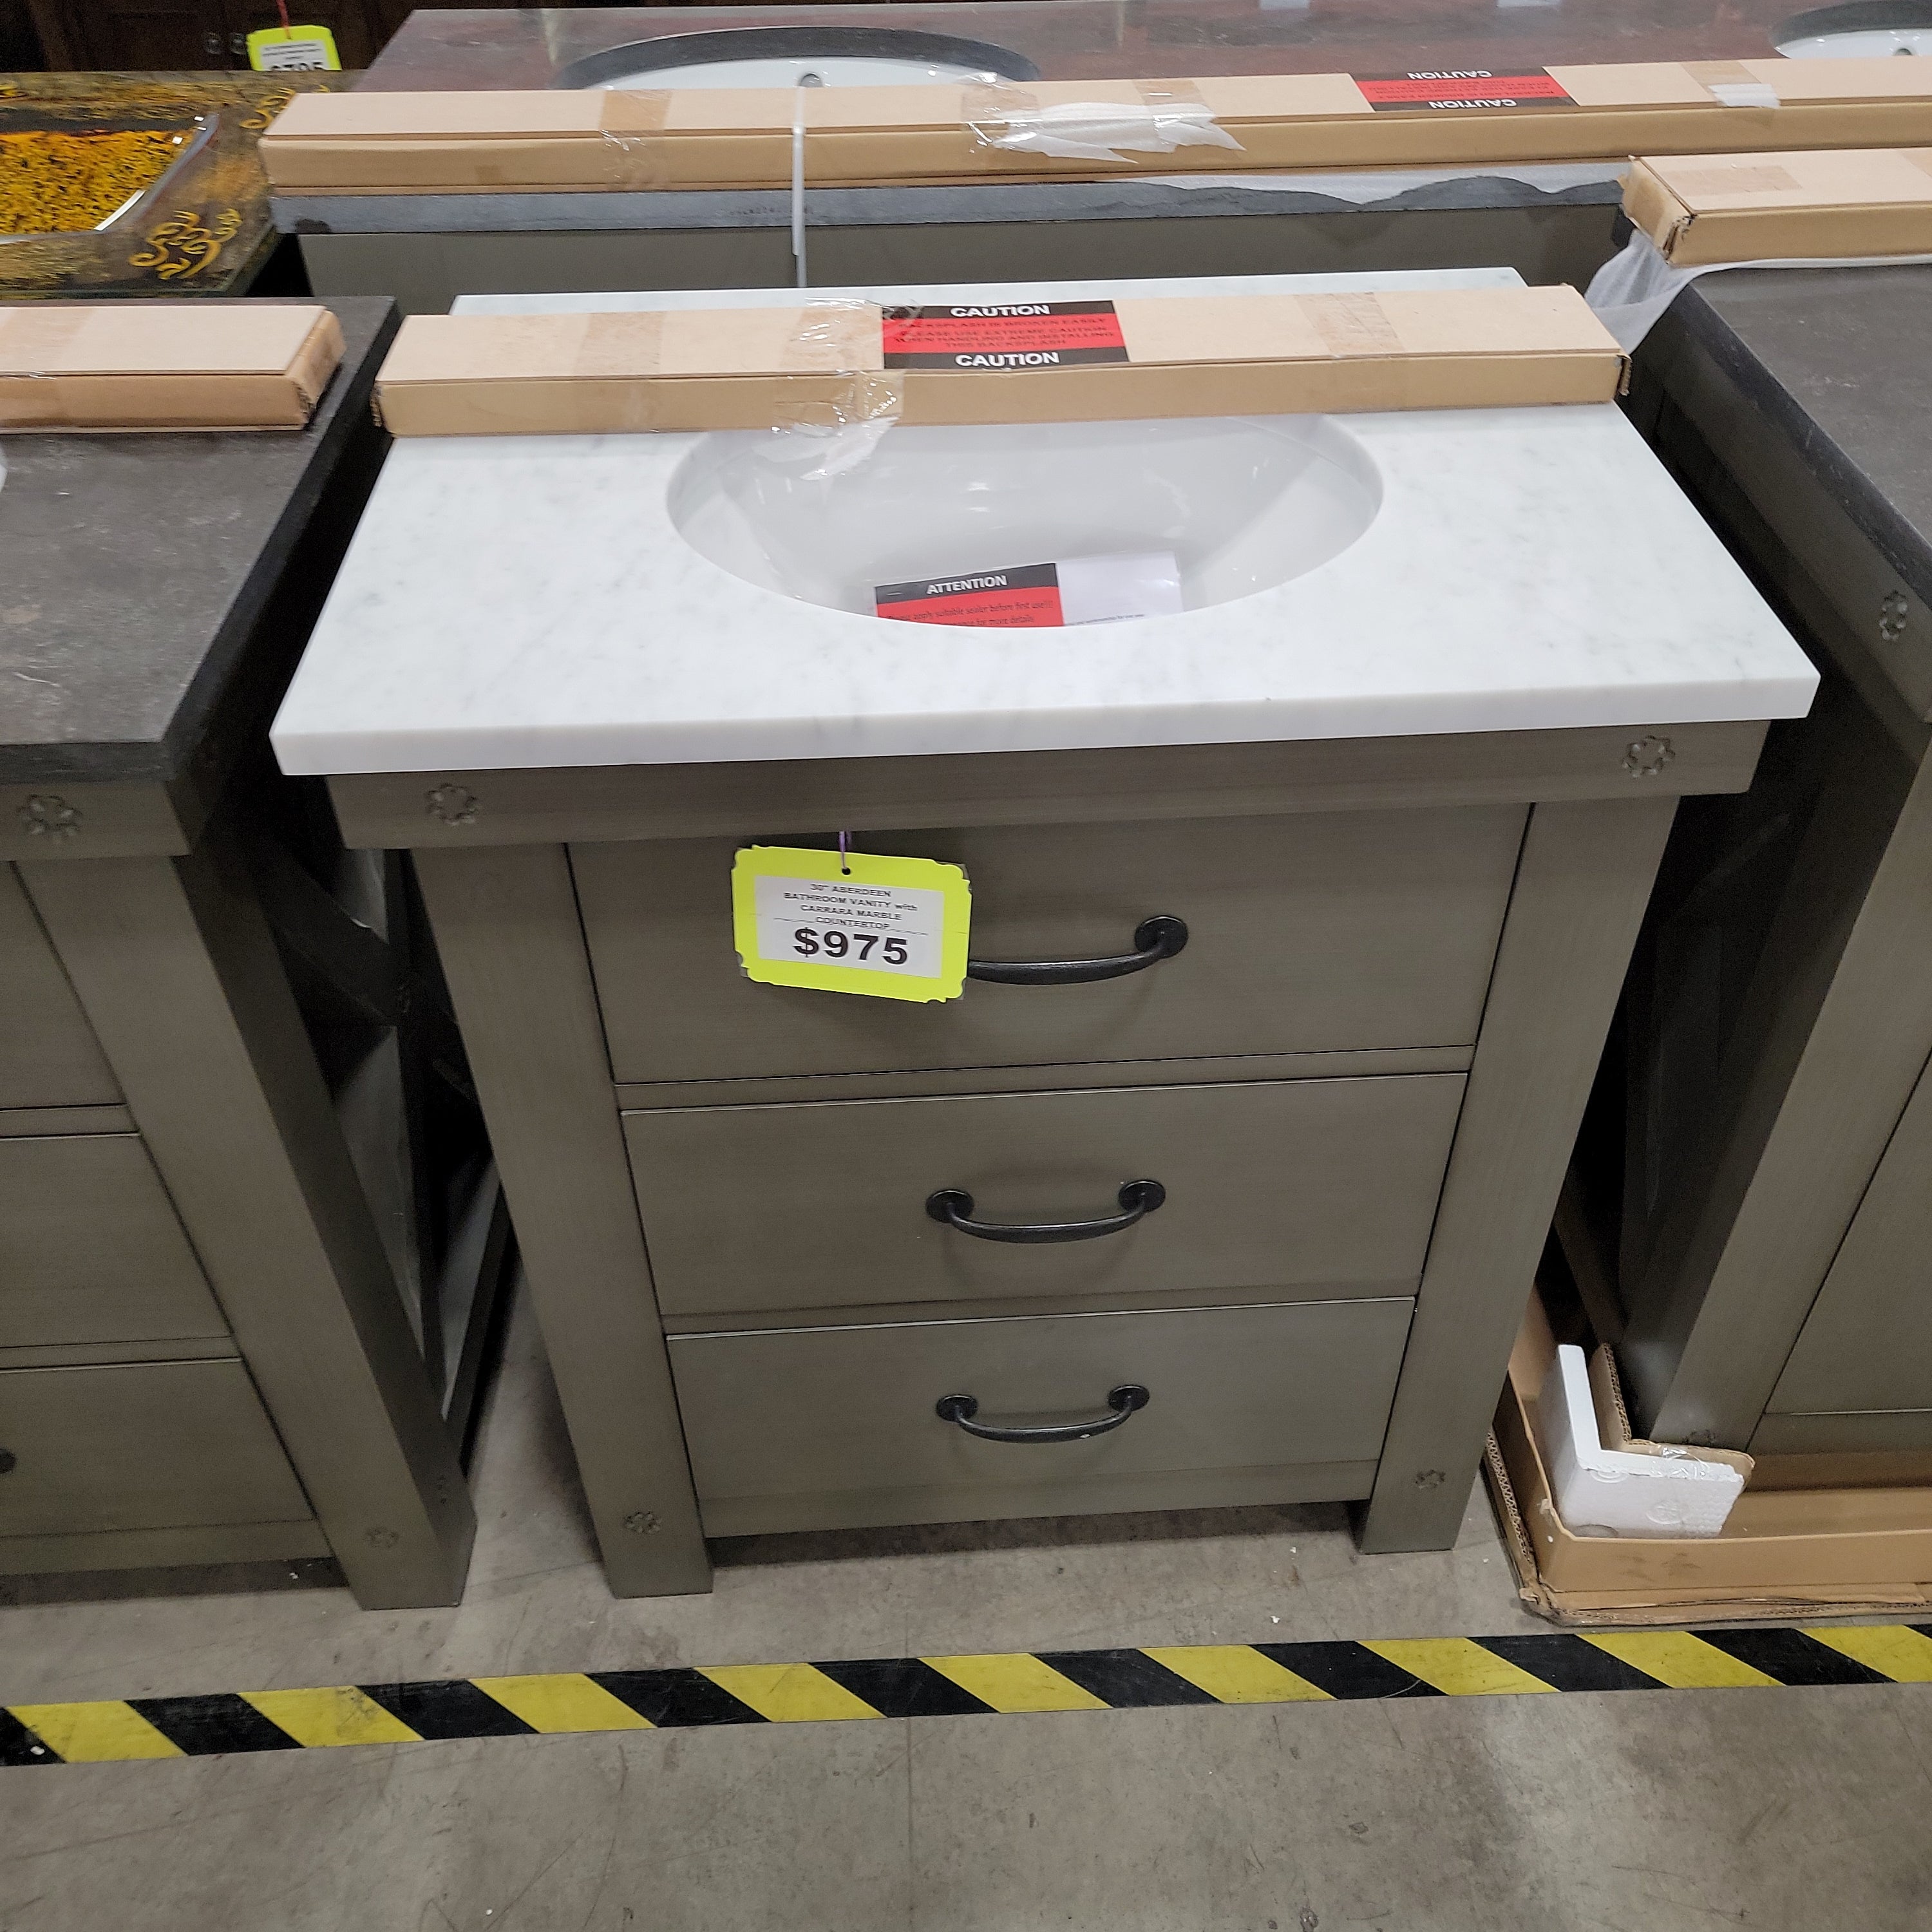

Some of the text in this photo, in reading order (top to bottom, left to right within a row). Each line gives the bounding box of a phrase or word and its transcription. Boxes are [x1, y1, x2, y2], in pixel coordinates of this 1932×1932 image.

[1406, 70, 1493, 80] CAUTION
[1428, 99, 1518, 109] CAUTION
[950, 305, 1051, 317] CAUTION
[955, 352, 1060, 366] CAUTION
[926, 575, 1008, 594] ATTENTION
[833, 886, 892, 897] ABERDEEN
[783, 892, 918, 911] BATHROOM VANITY with
[800, 905, 902, 920] CARRARA MARBLE
[816, 916, 891, 929] COUNTERTOP
[793, 927, 909, 966] $975
